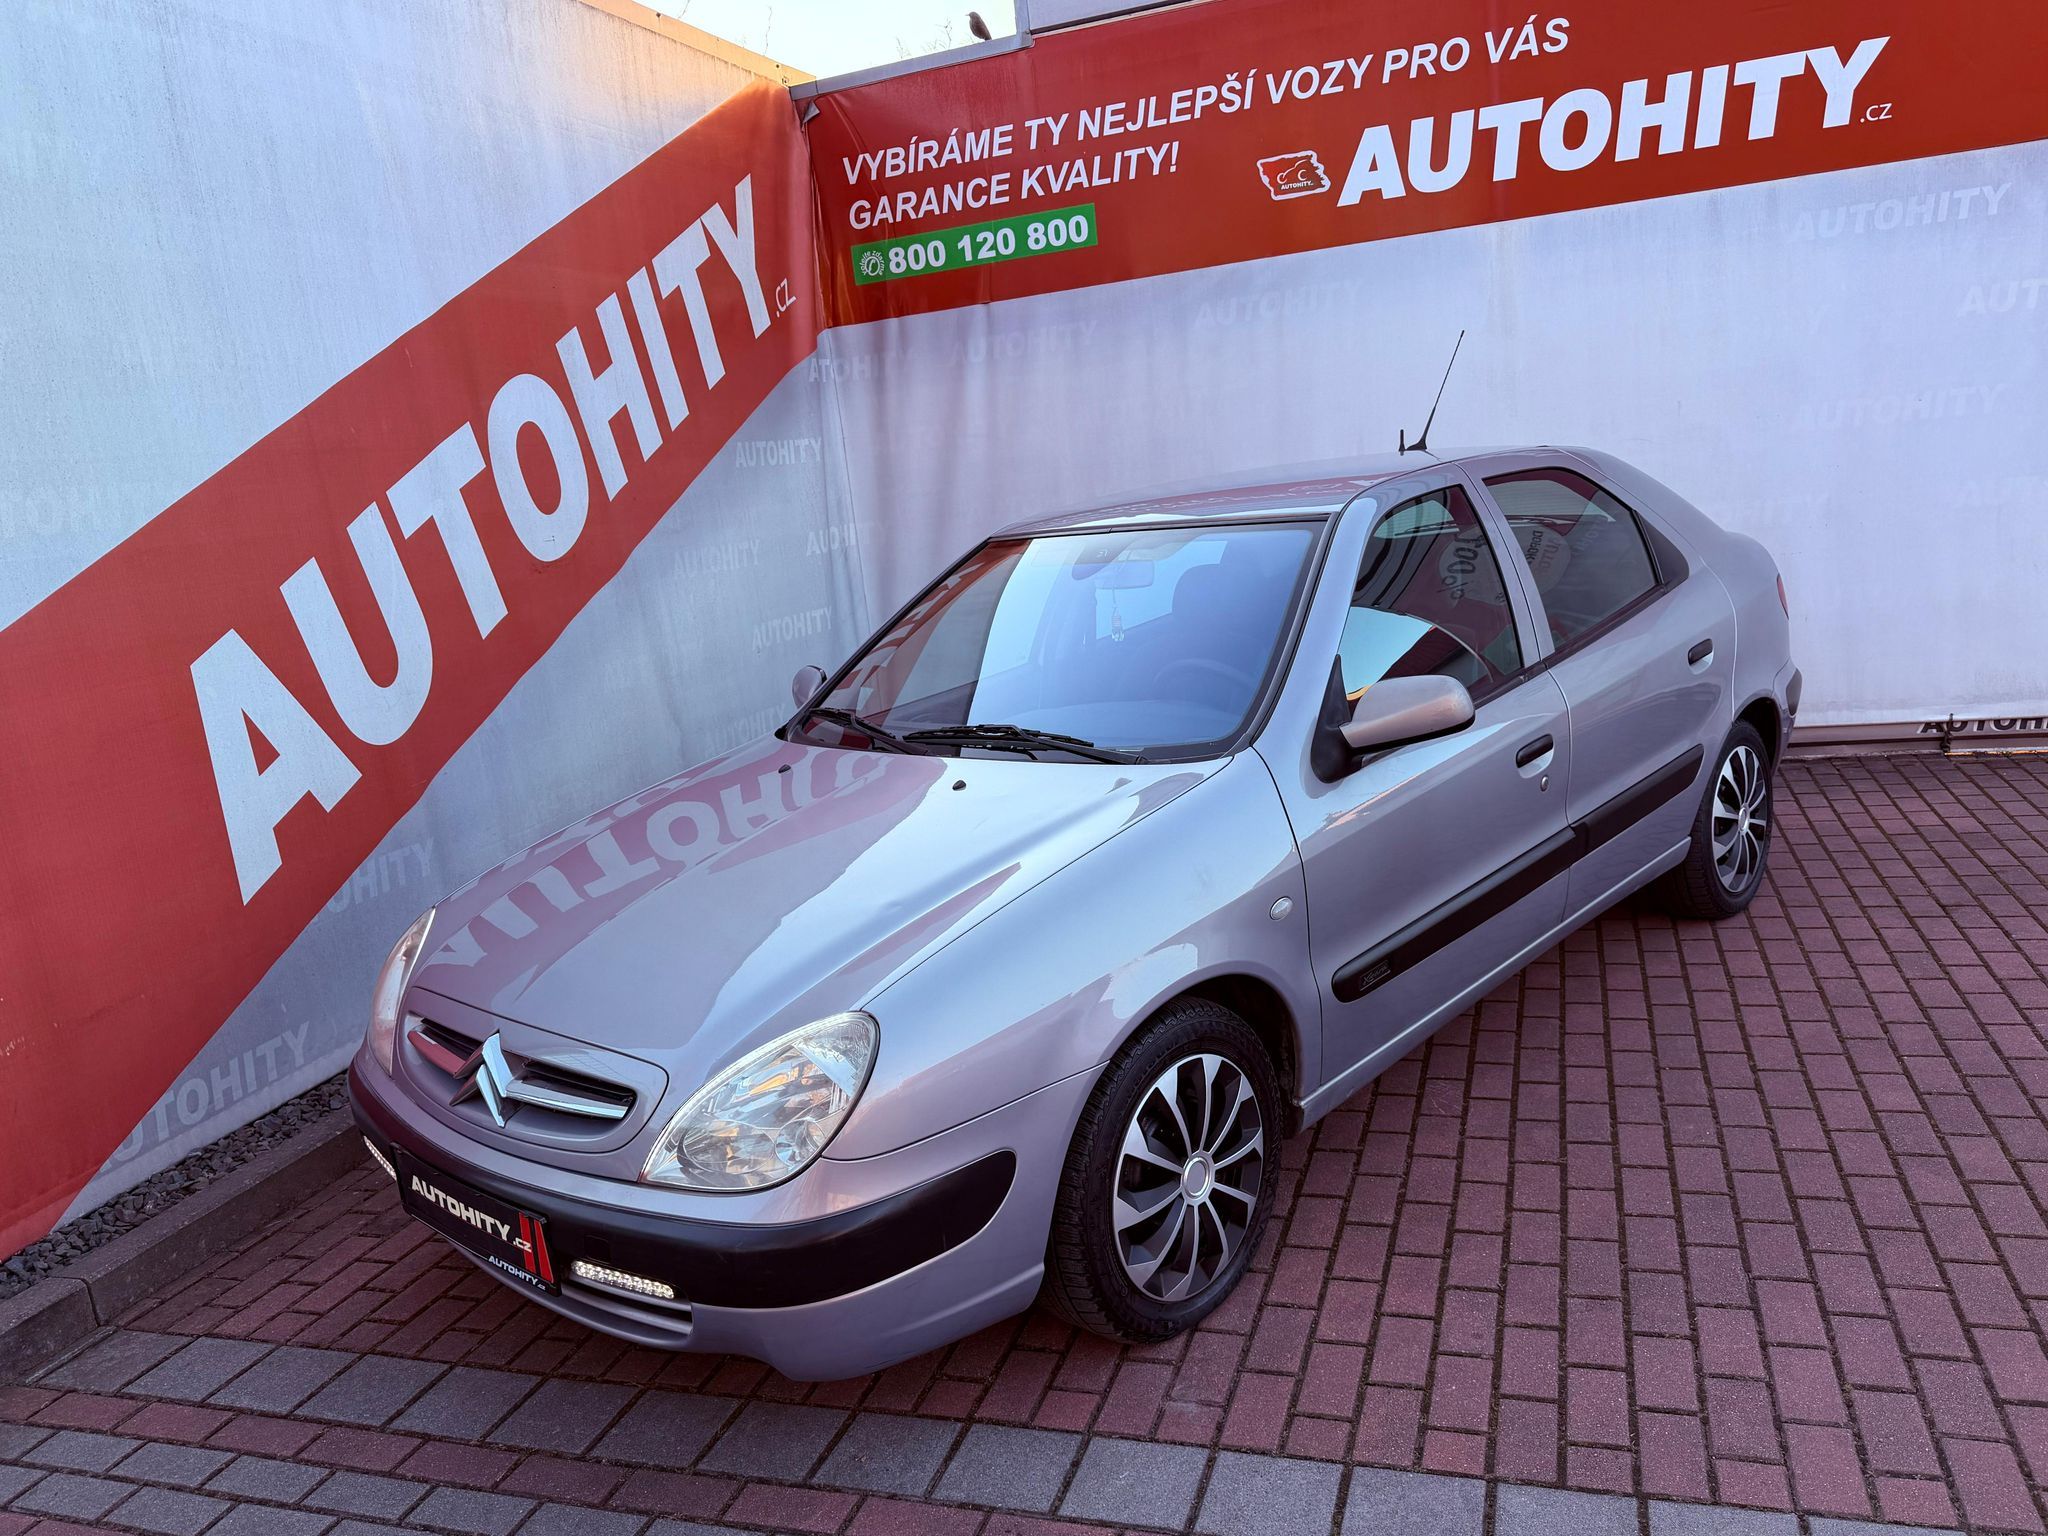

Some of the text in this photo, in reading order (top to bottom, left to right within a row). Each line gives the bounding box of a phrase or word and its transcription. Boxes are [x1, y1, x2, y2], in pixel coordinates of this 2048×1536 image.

[842, 14, 1570, 185] VYBÍRÁME TY NEJLEPŠÍ VOZY PRO VÁS
[849, 141, 1180, 230] GARANCE KVALITY!
[1785, 183, 2012, 243] AUTOHITY
[888, 214, 1090, 274] 800 120 800
[735, 437, 823, 469] AUTOHITY
[752, 606, 832, 651] AUTOHITY
